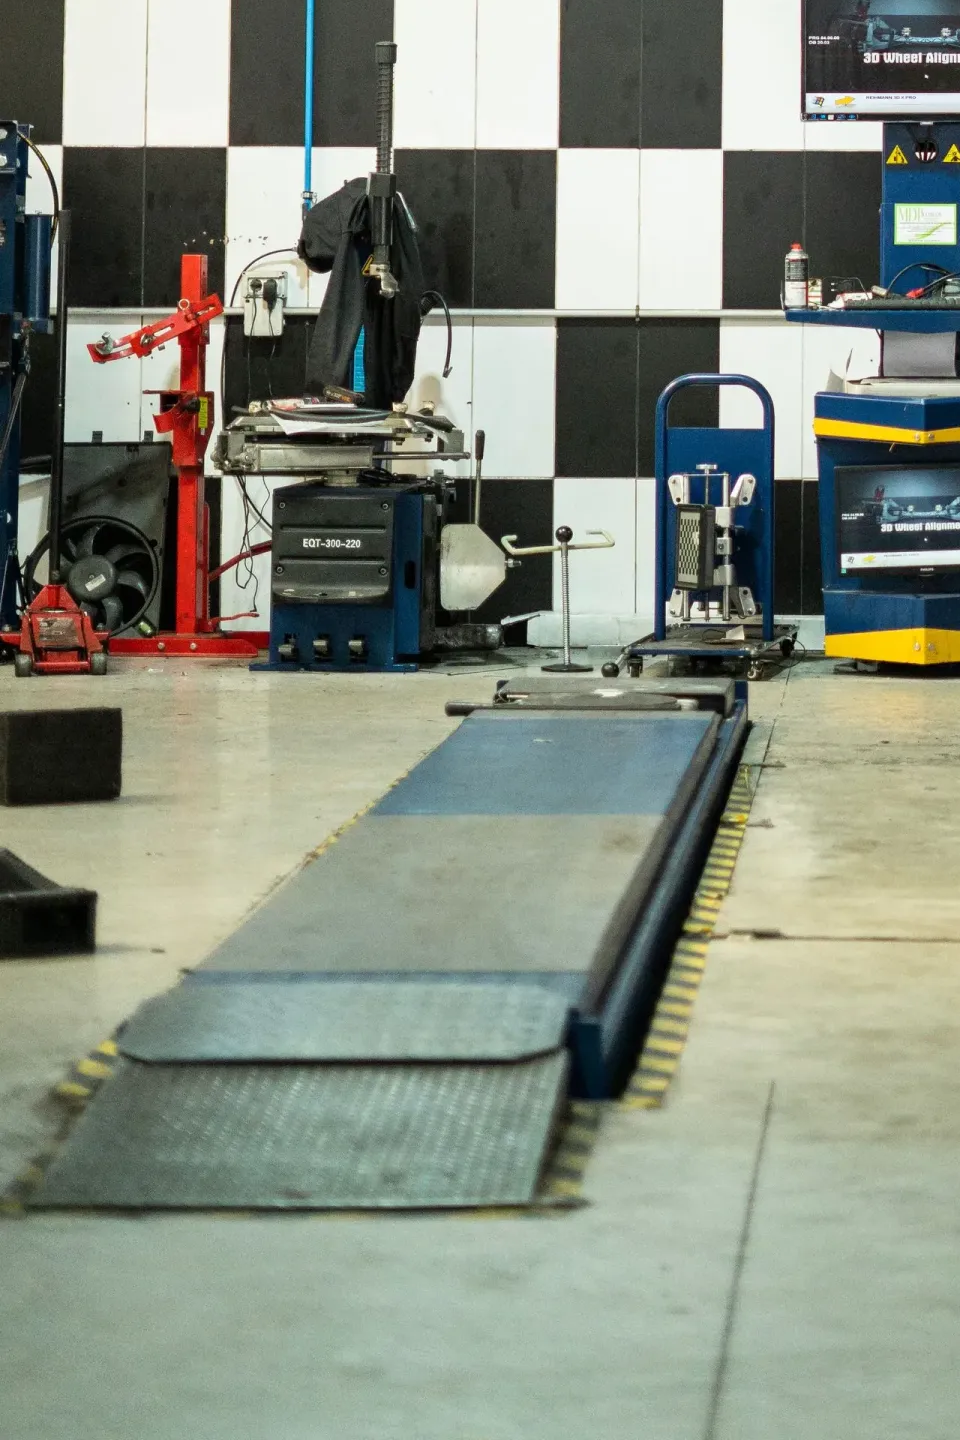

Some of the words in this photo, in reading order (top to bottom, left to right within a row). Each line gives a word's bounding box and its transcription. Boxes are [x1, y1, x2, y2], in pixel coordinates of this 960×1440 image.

[863, 52, 880, 64] 3D
[883, 52, 922, 64] Wheel
[880, 523, 893, 533] 3D
[894, 522, 923, 532] Wheel
[302, 538, 361, 549] EQT-300-220
